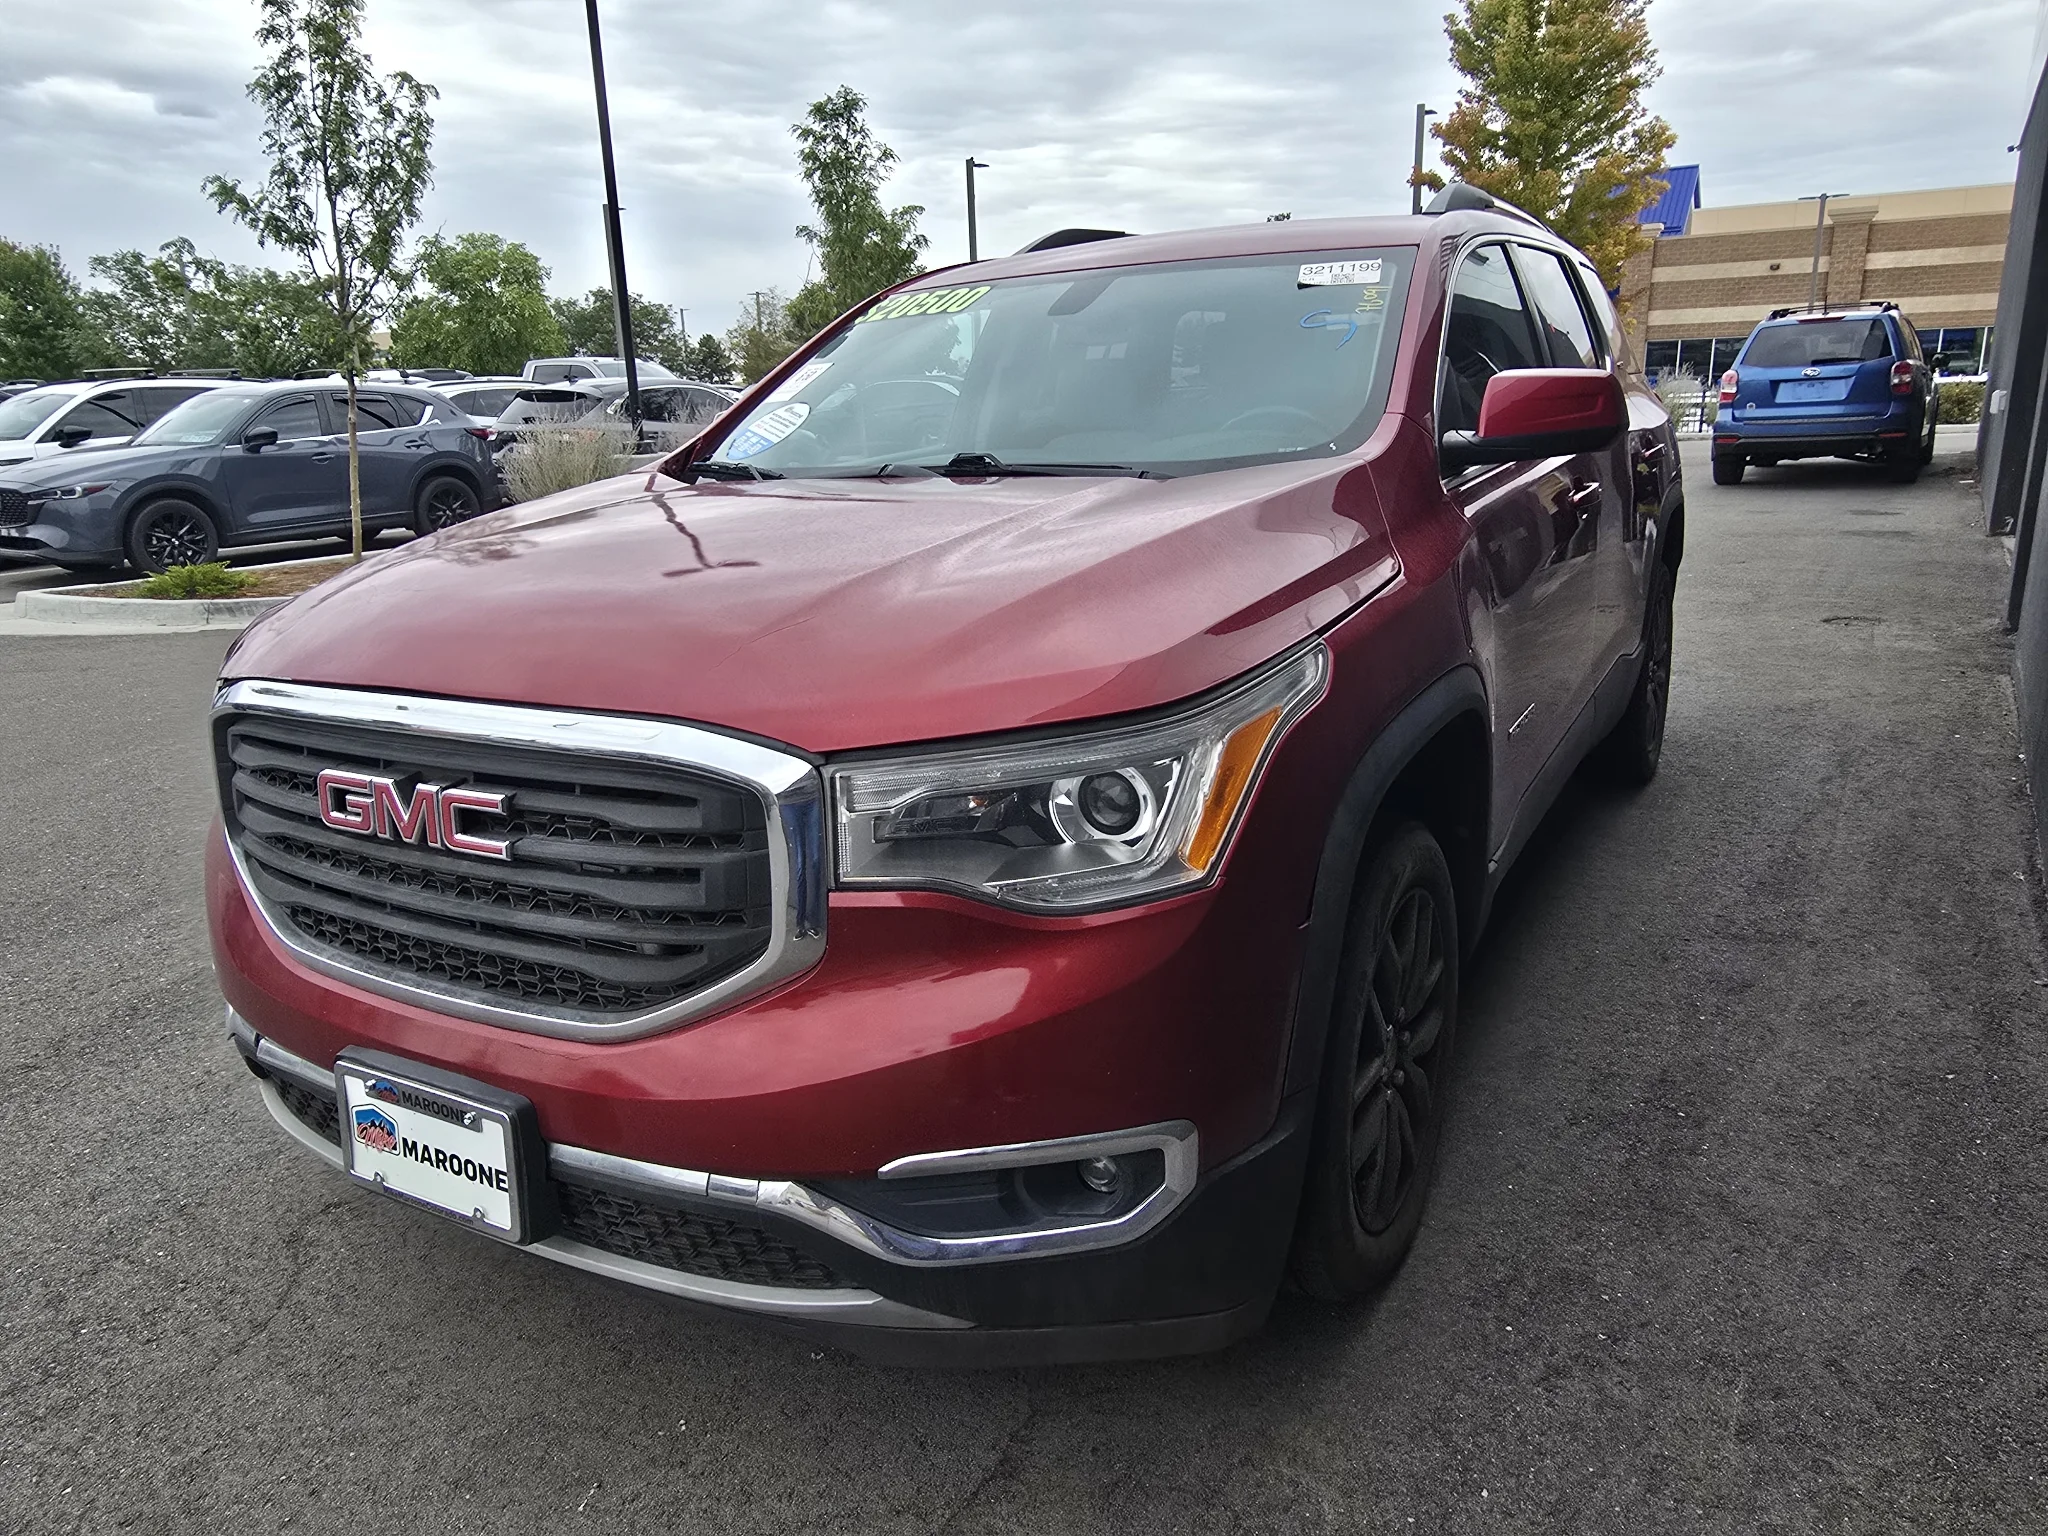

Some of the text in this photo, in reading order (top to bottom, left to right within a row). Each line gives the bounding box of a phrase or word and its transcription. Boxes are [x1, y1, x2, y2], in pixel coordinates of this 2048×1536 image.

[1302, 262, 1381, 276] 3211199
[317, 768, 511, 861] GMC
[402, 1136, 509, 1193] MAROONE
